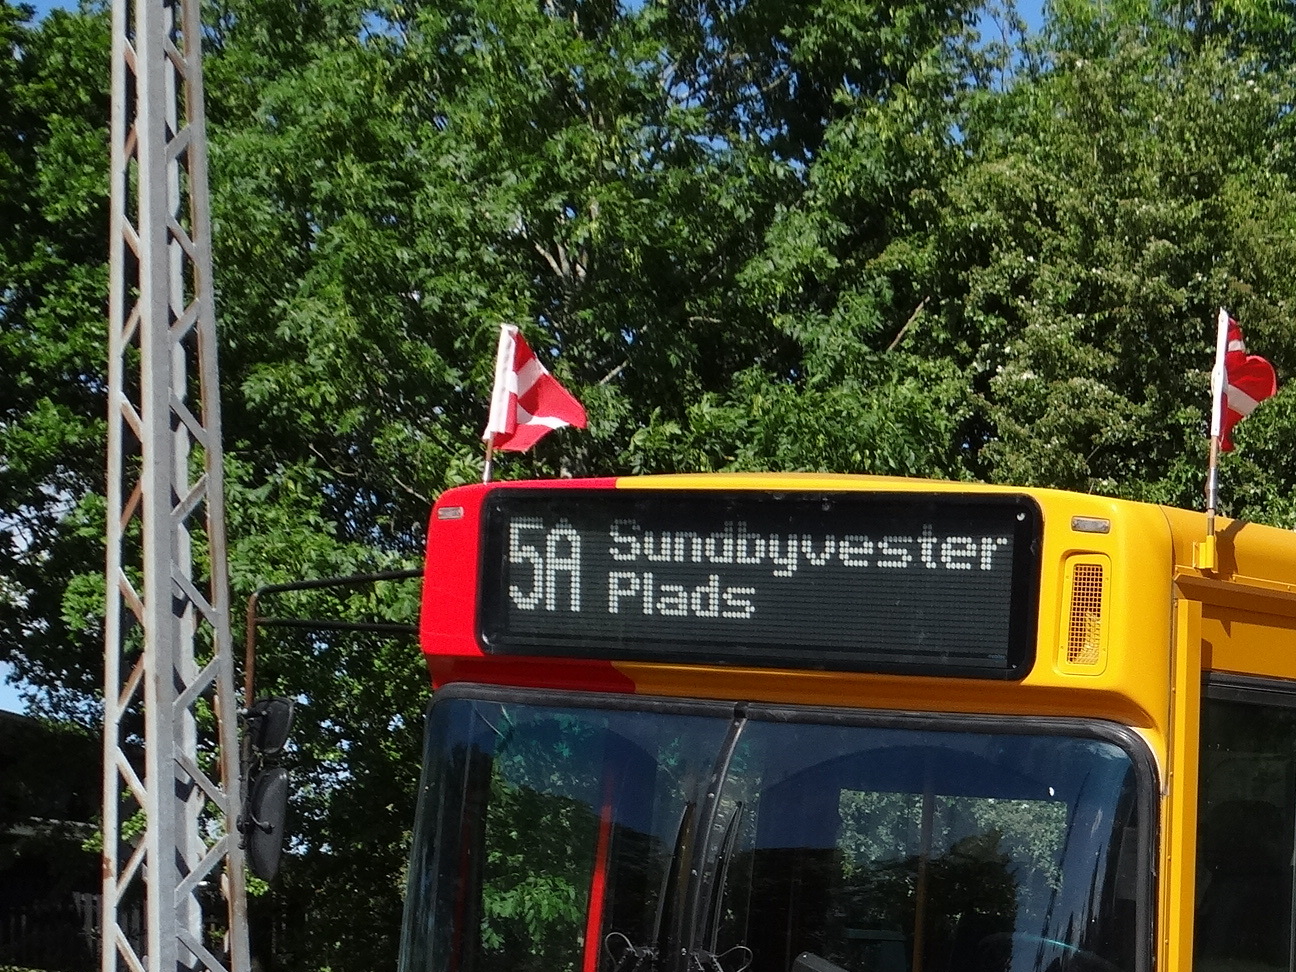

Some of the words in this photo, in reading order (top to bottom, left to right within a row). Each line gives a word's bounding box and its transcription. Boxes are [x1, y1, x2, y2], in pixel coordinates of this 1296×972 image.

[508, 517, 581, 612] 5A
[608, 518, 1008, 577] Sundbyvester
[608, 571, 756, 620] Plads
